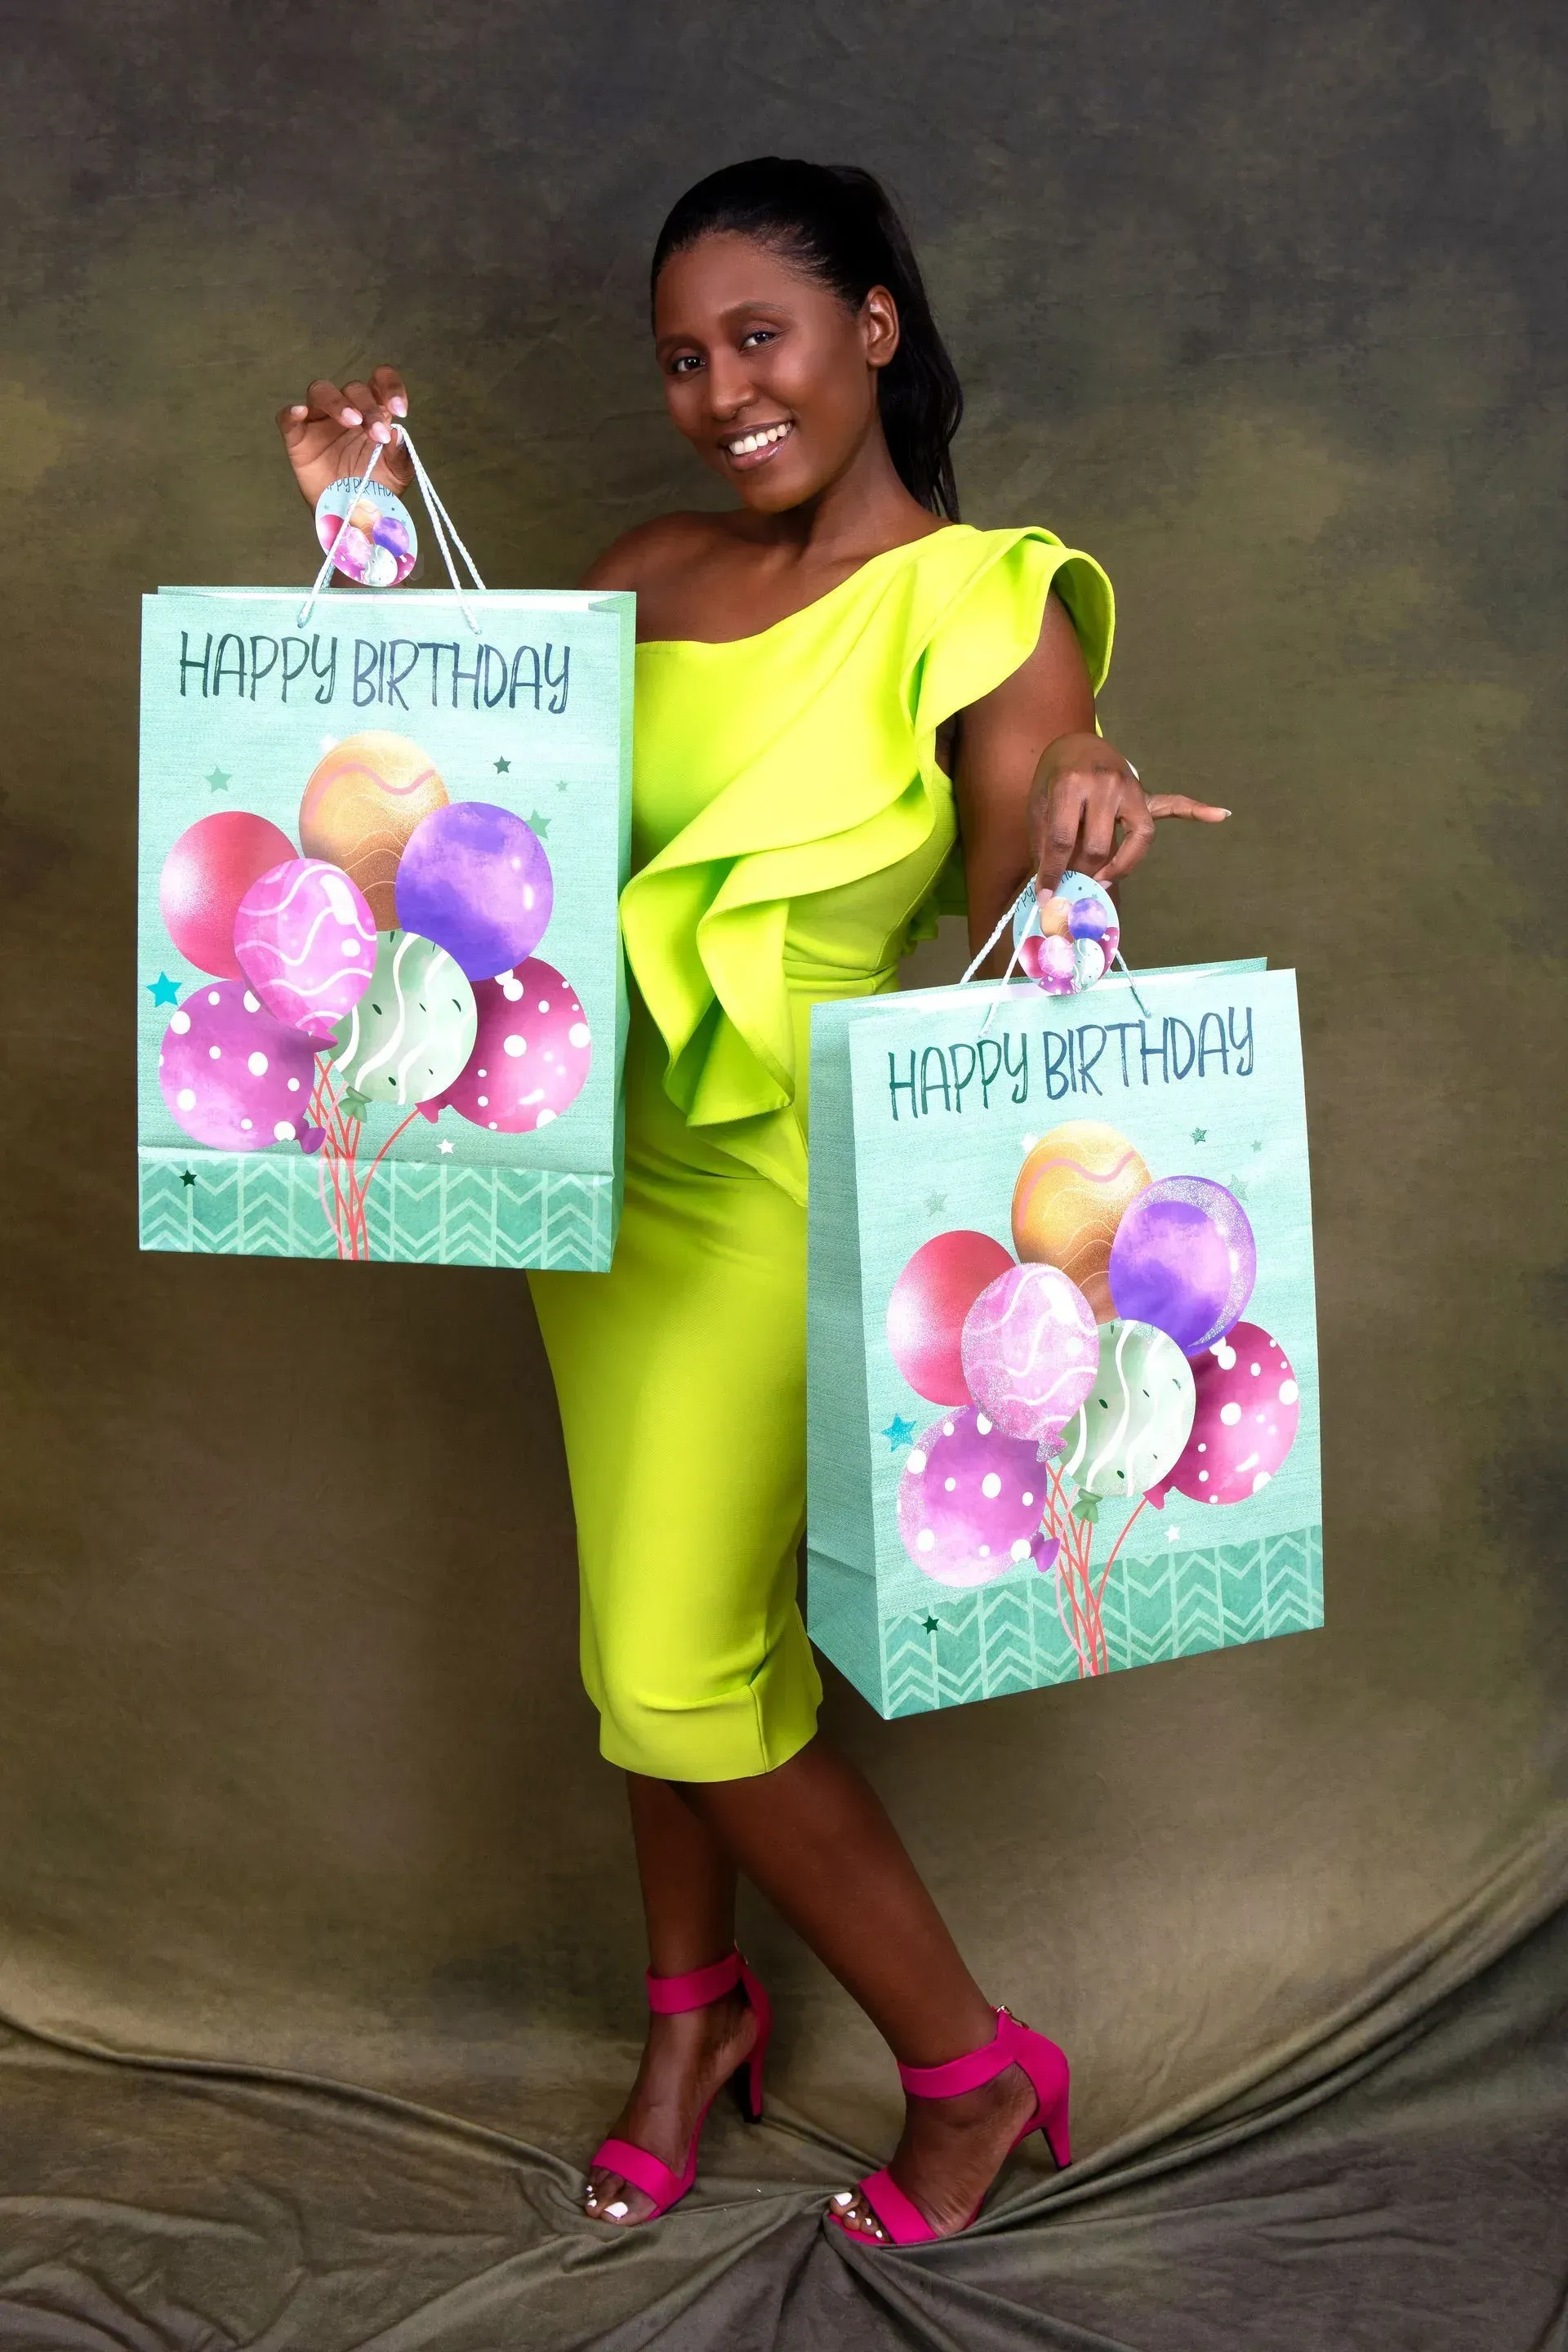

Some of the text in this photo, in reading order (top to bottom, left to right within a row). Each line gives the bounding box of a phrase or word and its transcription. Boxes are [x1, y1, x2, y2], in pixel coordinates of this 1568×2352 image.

[179, 630, 571, 715] HAPPY BIRTHDAY
[888, 1005, 1254, 1121] HAPPY BIRTHDAY
